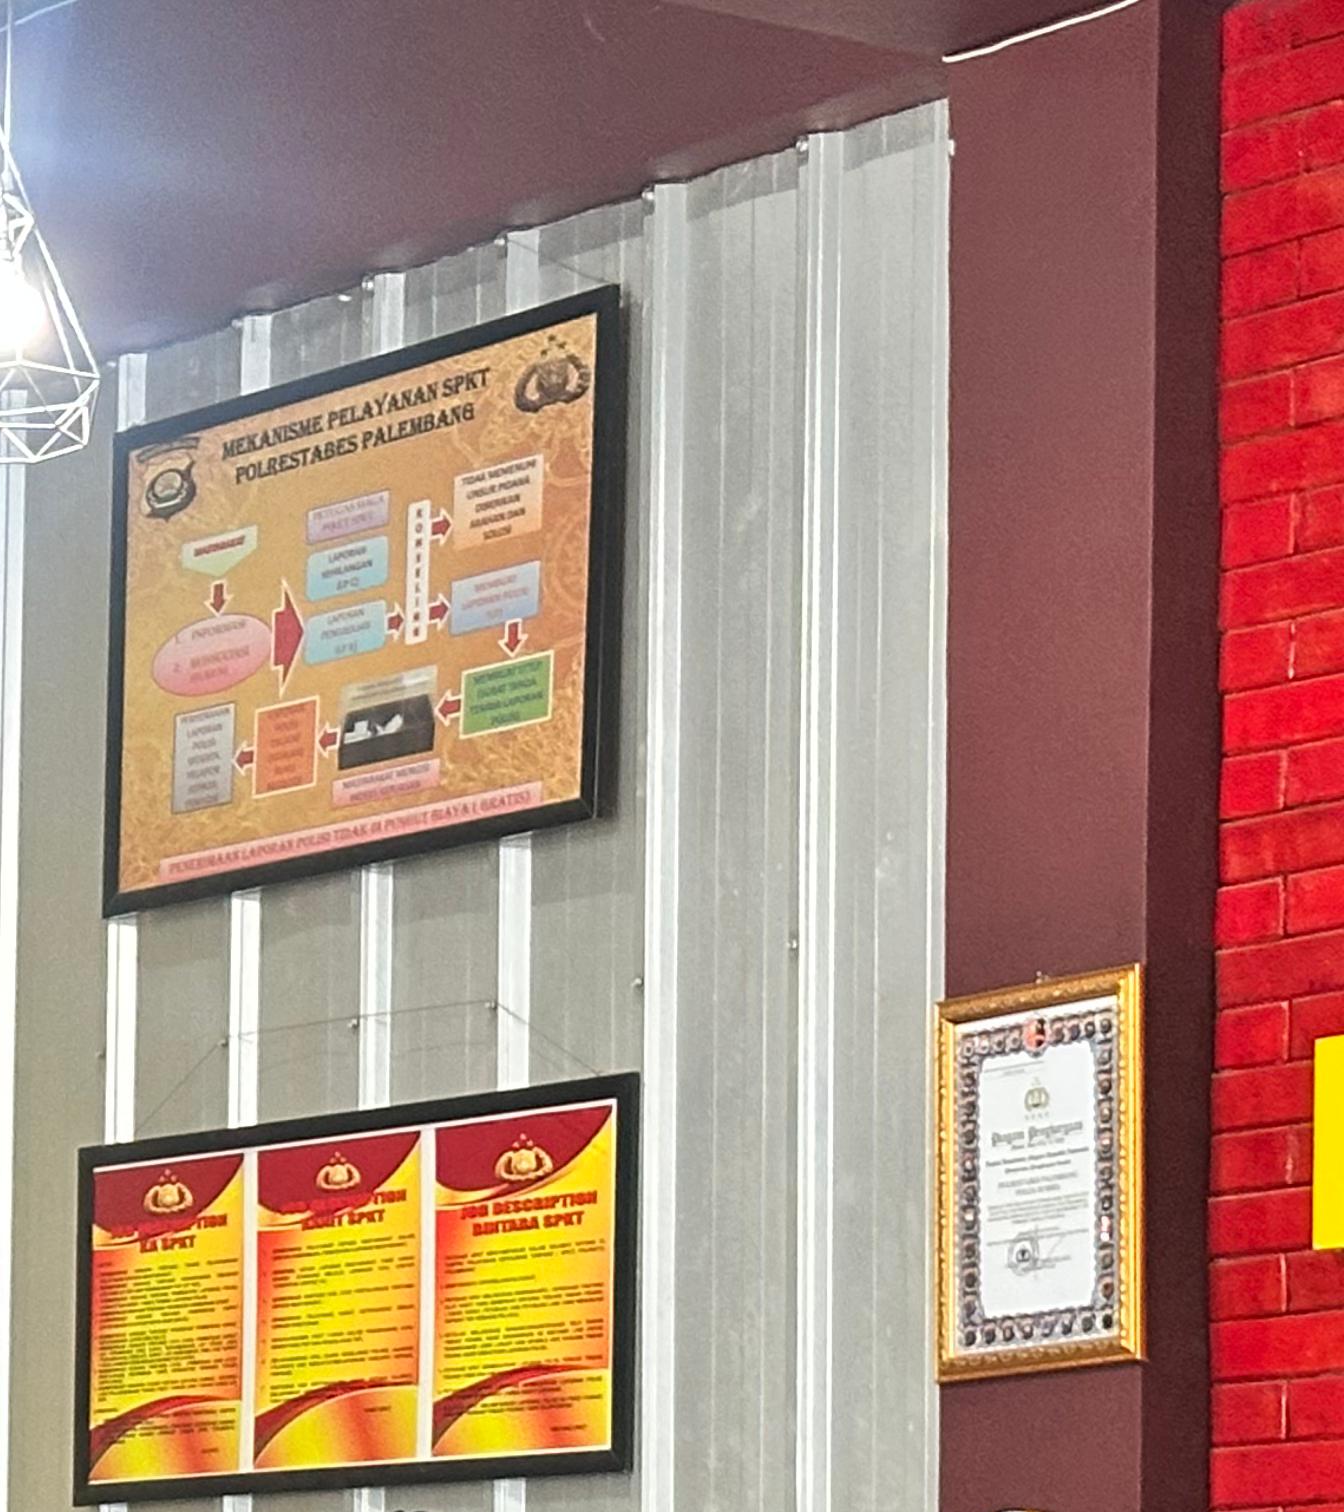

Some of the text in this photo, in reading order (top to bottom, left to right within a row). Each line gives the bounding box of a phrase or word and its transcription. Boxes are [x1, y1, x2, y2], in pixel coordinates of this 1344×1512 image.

[222, 416, 323, 460] MEKANISME
[328, 381, 439, 430] PELAYANAN
[442, 368, 490, 398] SPKT
[236, 435, 358, 485] POLRESTABES
[363, 403, 475, 450] PALEMBANG
[493, 1191, 597, 1214] DESCRIPTION
